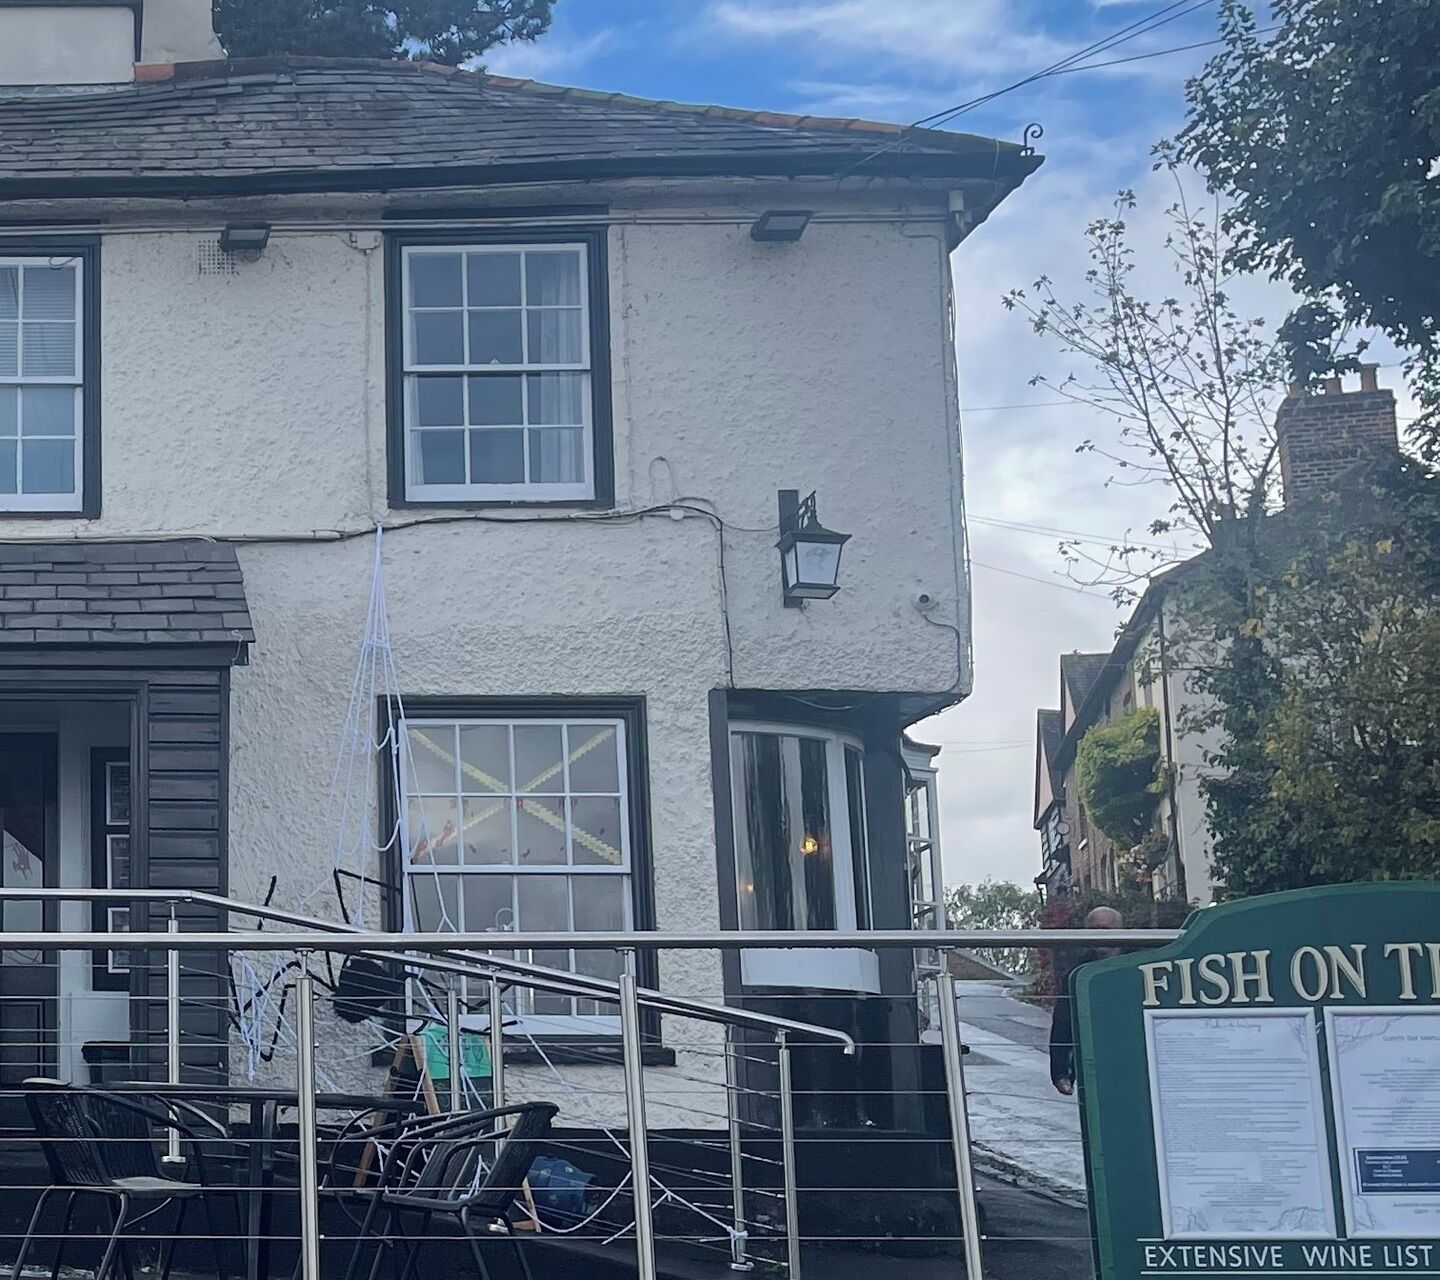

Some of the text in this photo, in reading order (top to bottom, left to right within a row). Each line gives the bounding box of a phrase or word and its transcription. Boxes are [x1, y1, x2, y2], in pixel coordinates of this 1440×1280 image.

[1137, 949, 1275, 1007] FISH
[1289, 943, 1367, 1003] ON
[1144, 1244, 1434, 1268] EXTENSIVE WINE LIST
